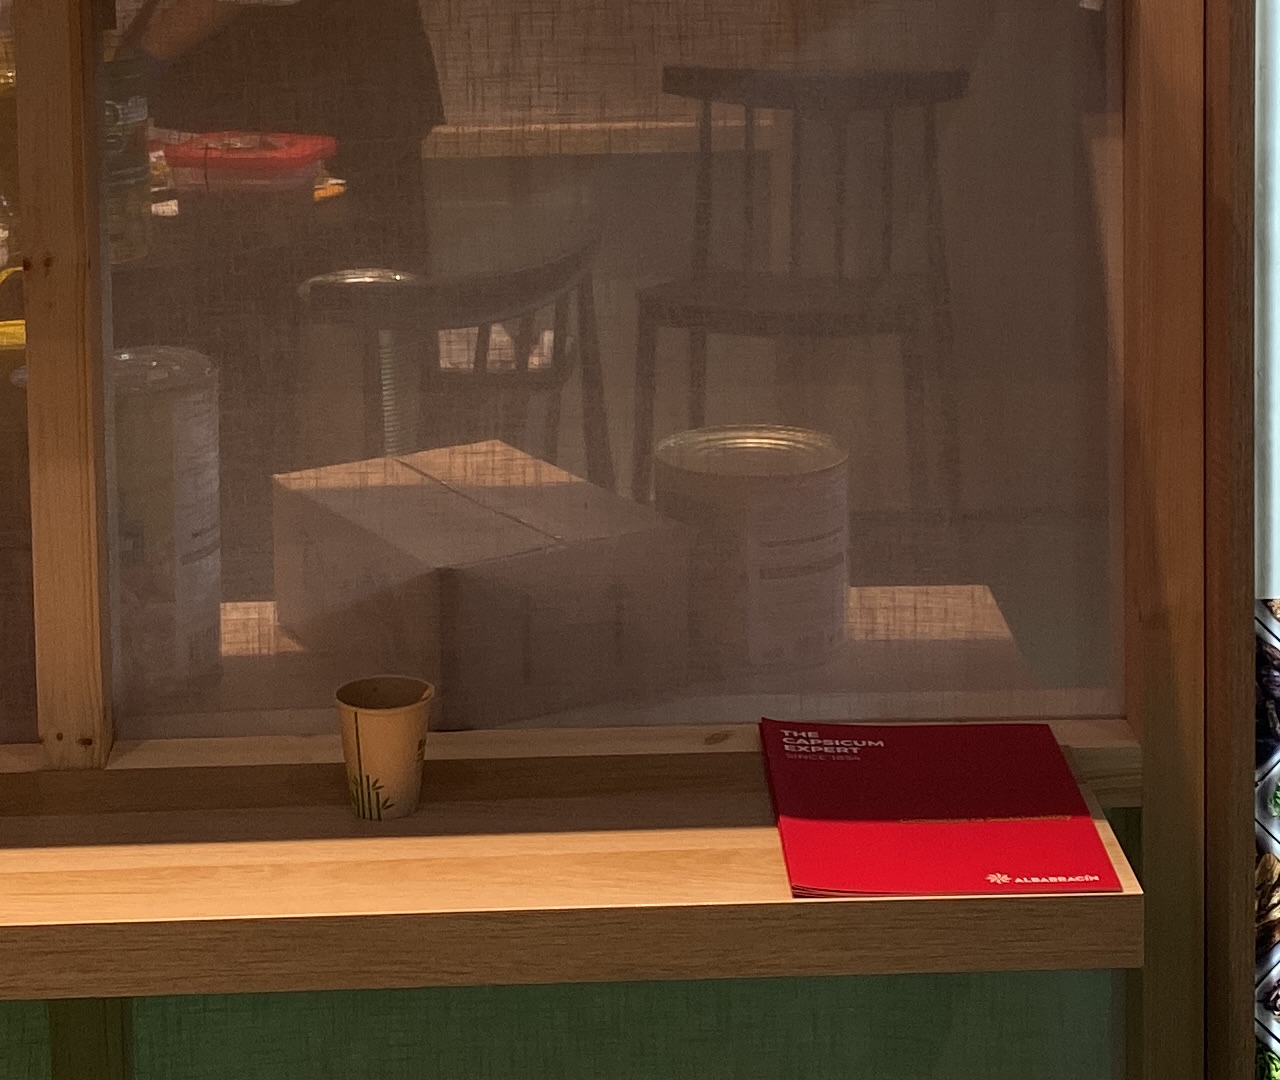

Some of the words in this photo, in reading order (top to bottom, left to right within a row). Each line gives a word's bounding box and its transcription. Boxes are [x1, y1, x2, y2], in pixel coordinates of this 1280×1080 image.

[780, 729, 819, 738] THE
[782, 737, 885, 748] CAPSICUM
[784, 744, 861, 754] EXPERT
[1014, 874, 1100, 884] ALBARRACÍN
